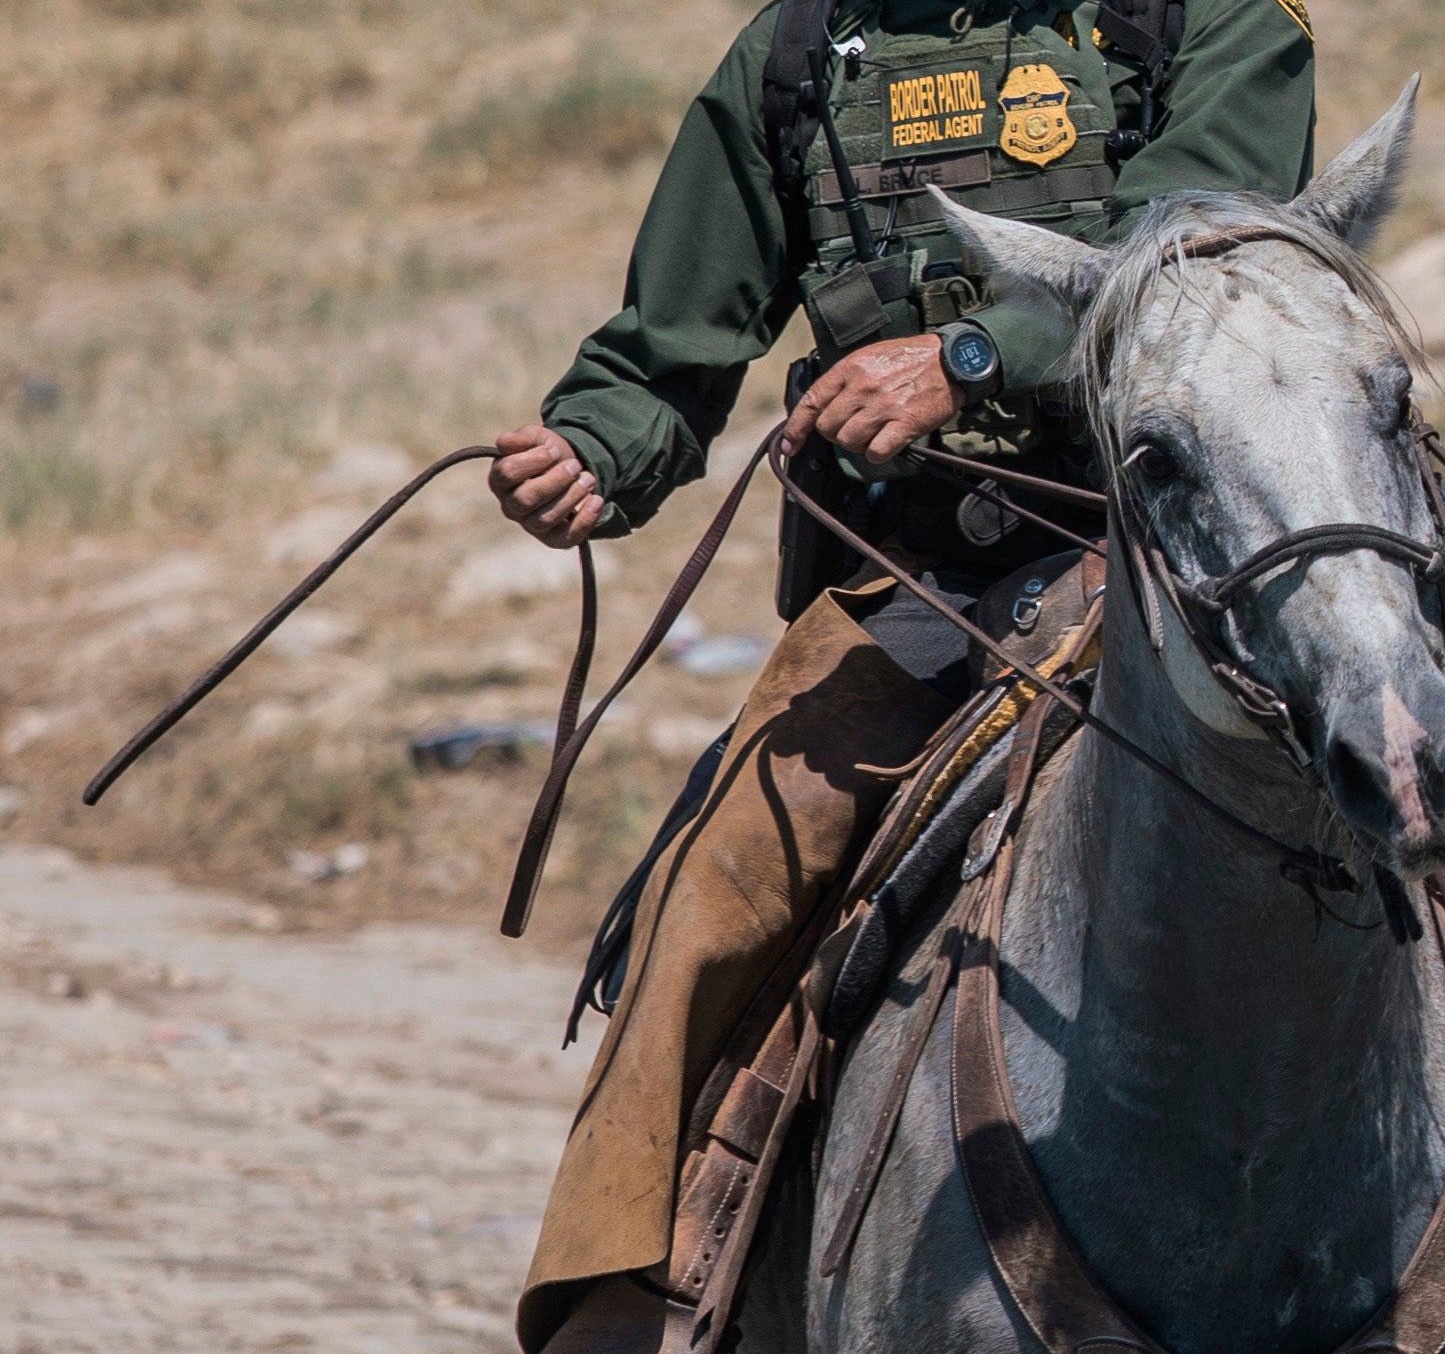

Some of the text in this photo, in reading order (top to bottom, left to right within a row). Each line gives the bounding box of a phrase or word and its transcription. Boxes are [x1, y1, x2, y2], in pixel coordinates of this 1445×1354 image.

[890, 70, 987, 123] BORDER PATROL
[892, 113, 984, 147] FEDERAL AGENT
